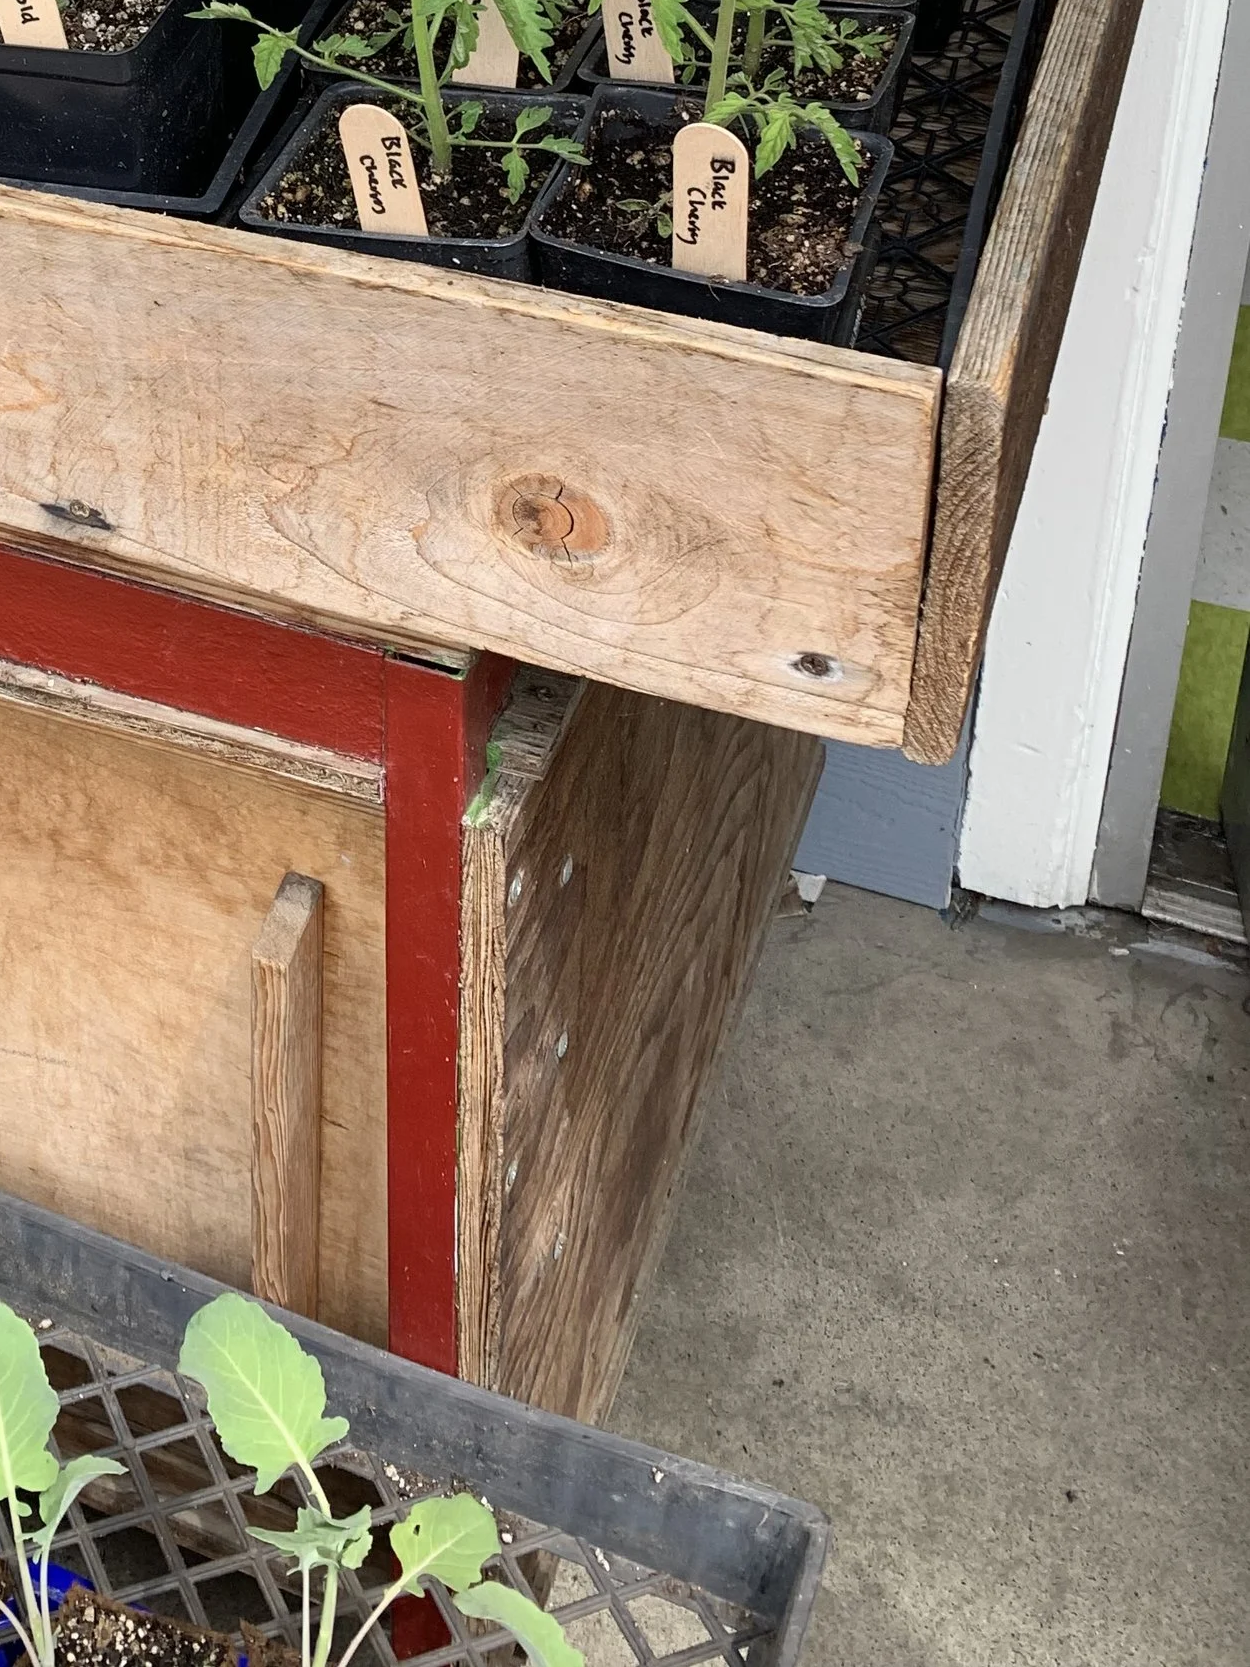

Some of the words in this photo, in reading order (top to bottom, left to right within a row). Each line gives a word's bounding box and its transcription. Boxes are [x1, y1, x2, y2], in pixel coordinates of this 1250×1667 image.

[614, 11, 637, 66] Cherry
[380, 135, 408, 190] Black
[710, 155, 736, 211] Black
[675, 187, 707, 246] Cherry
